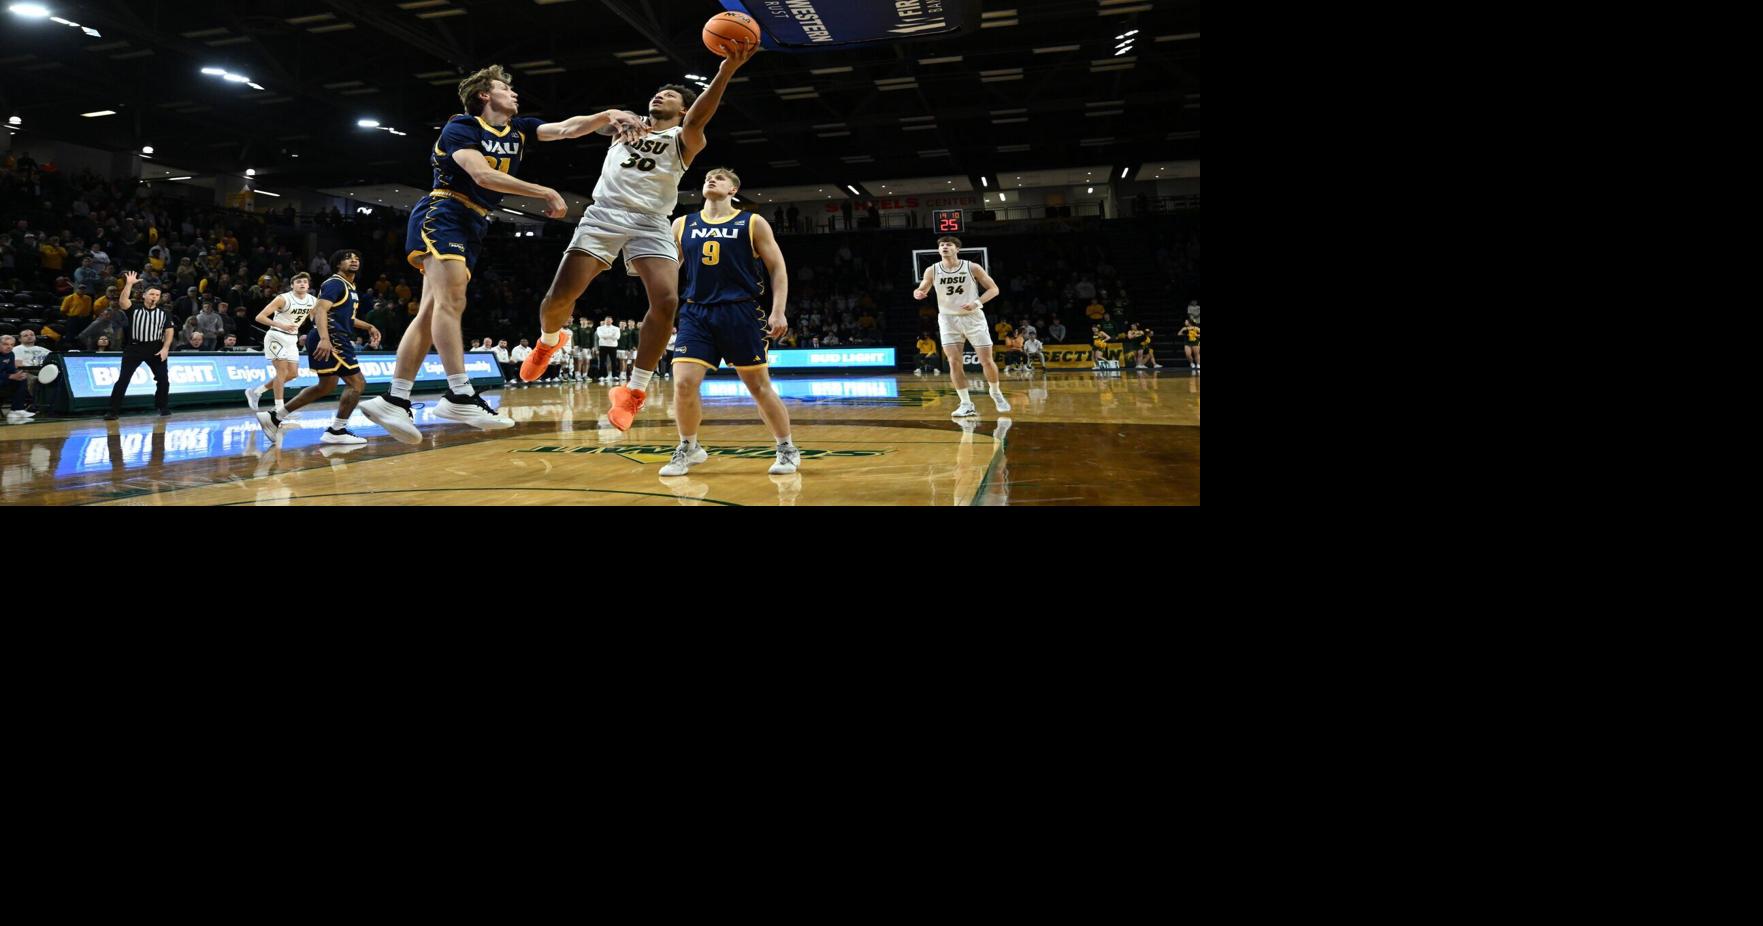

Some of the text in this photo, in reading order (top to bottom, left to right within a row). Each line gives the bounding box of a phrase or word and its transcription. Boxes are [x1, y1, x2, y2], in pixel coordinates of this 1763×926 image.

[624, 138, 669, 155] DSU
[620, 153, 656, 171] 30
[940, 218, 958, 231] 25
[690, 227, 739, 239] NAU
[701, 240, 721, 266] 9
[939, 276, 966, 285] NDSU
[945, 285, 965, 296] 34
[294, 315, 304, 323] 5
[810, 352, 885, 363] BUD LIGHT
[1043, 350, 1122, 363] SECTIN
[92, 366, 149, 386] BD
[226, 366, 266, 382] Enjoy
